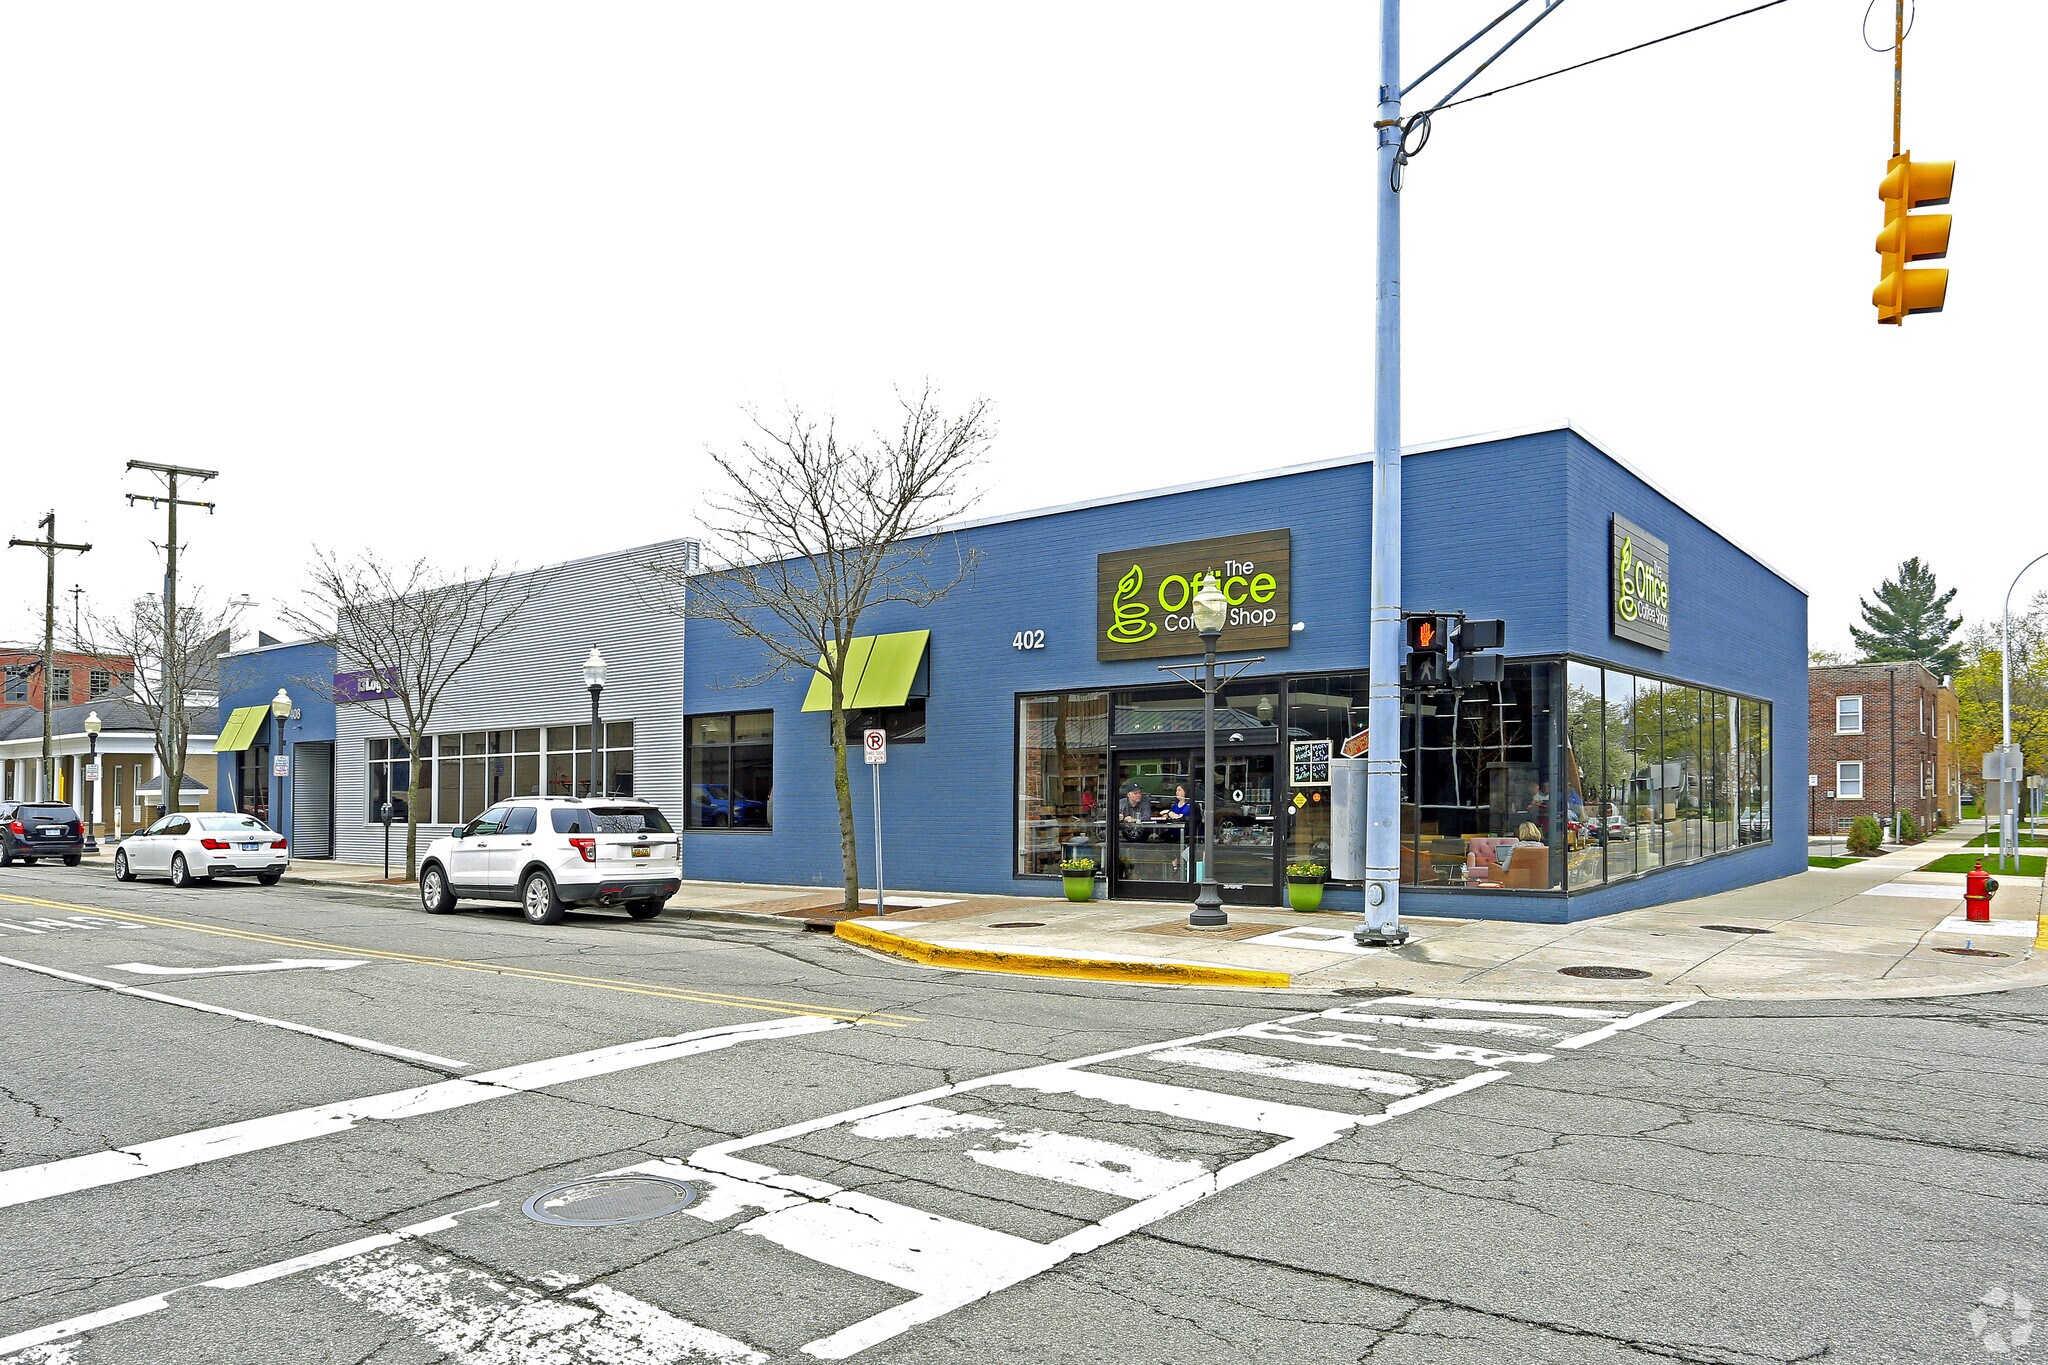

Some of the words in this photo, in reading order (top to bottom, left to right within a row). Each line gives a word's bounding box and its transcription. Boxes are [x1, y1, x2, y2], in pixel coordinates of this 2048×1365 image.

[1225, 560, 1254, 577] The
[1653, 560, 1662, 578] The
[1158, 570, 1277, 612] Ofice
[1635, 560, 1668, 609] Office
[1229, 607, 1277, 627] Shop
[1637, 600, 1656, 623] Coffee
[1012, 629, 1045, 650] 402
